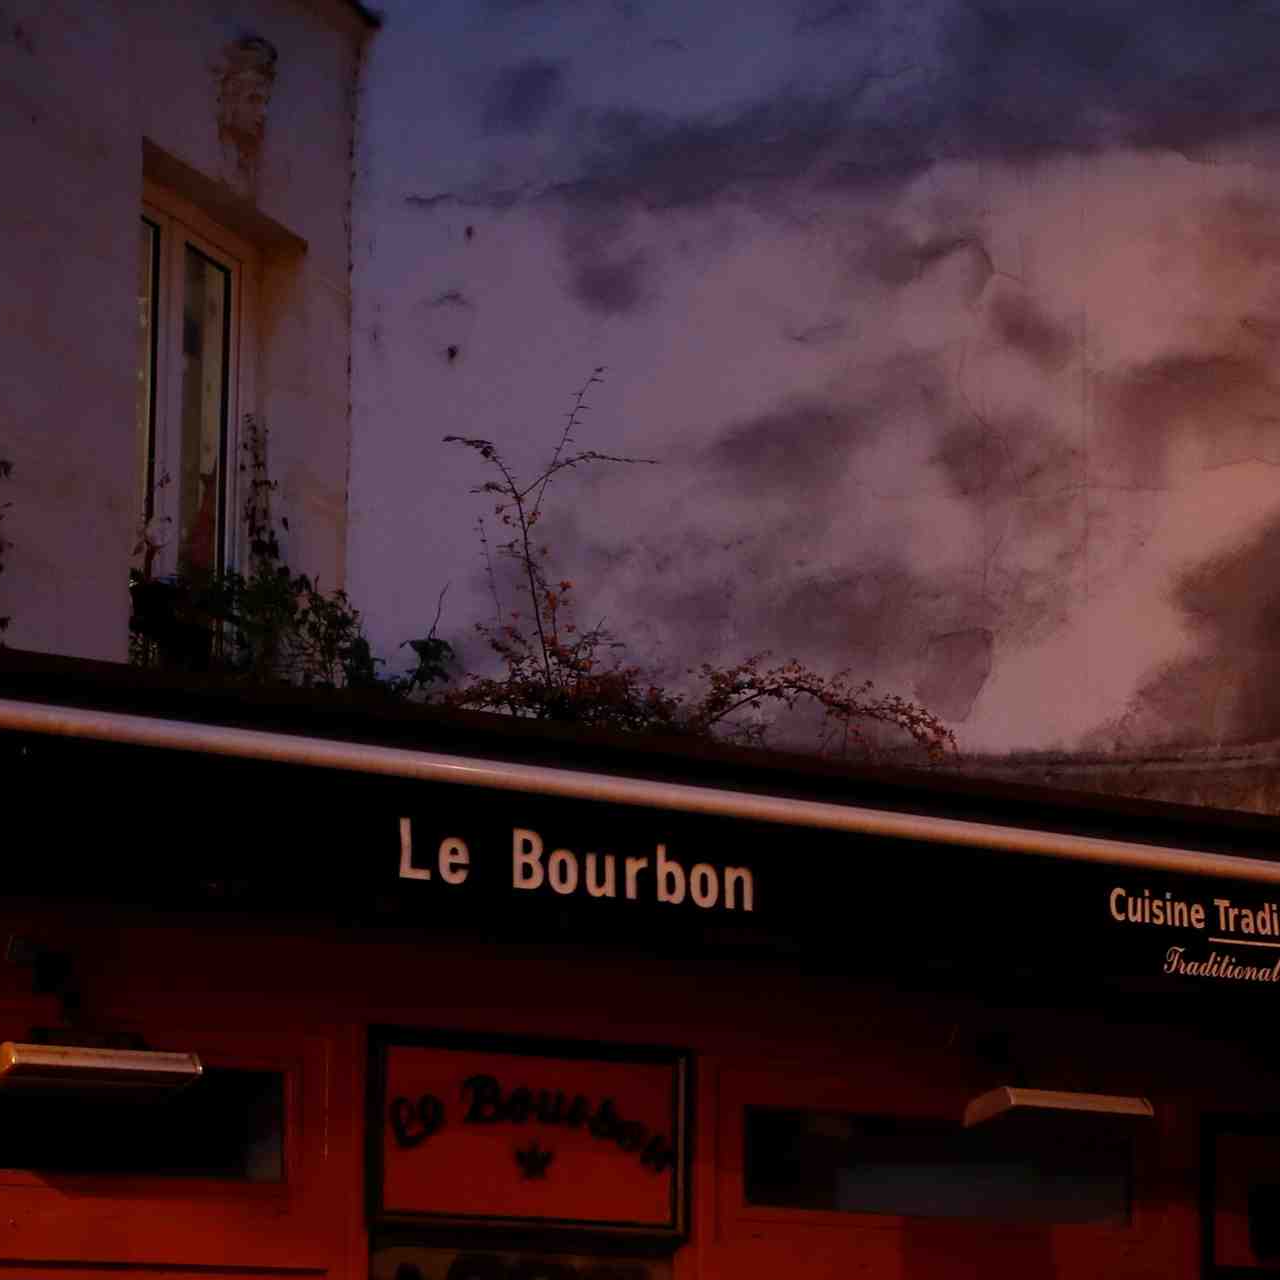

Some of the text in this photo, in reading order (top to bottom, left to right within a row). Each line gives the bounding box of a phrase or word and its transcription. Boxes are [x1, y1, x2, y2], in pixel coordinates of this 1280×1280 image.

[398, 816, 754, 913] Le Bourbon
[1108, 886, 1207, 929] Cuisine
